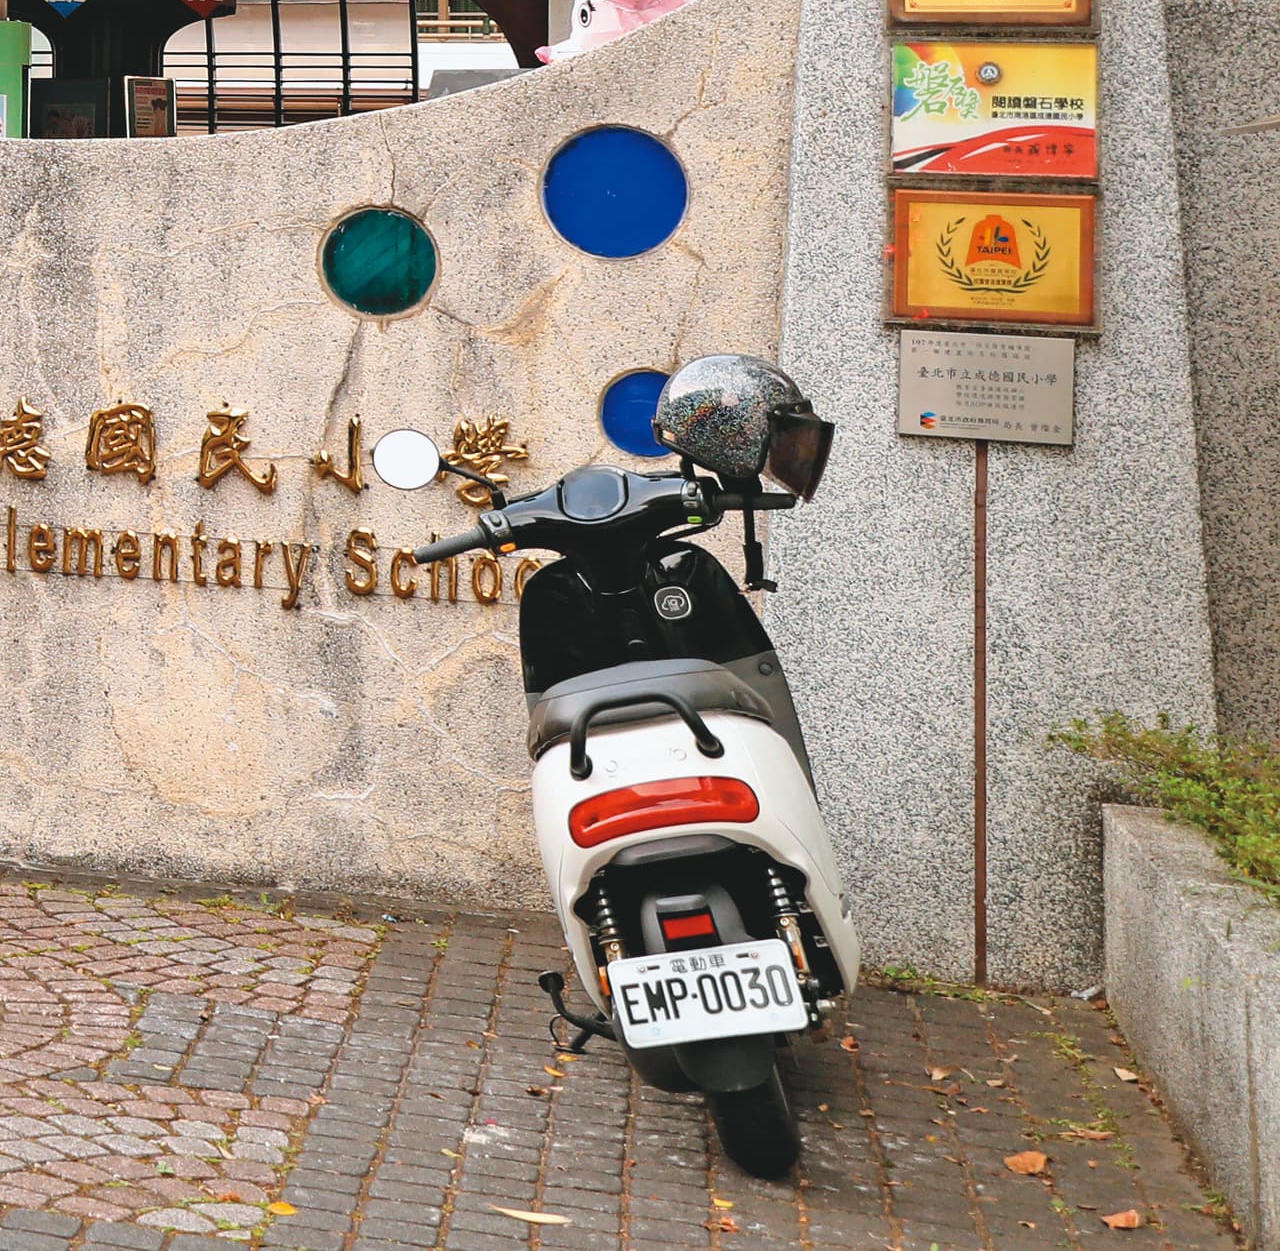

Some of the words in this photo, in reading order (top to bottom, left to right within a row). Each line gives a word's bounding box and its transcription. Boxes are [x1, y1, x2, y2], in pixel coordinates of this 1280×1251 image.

[976, 245, 1012, 256] TAIPEI
[917, 366, 1058, 387] 臺北市立成德國民小學
[345, 525, 542, 606] Schoo
[669, 954, 725, 974] 電動車
